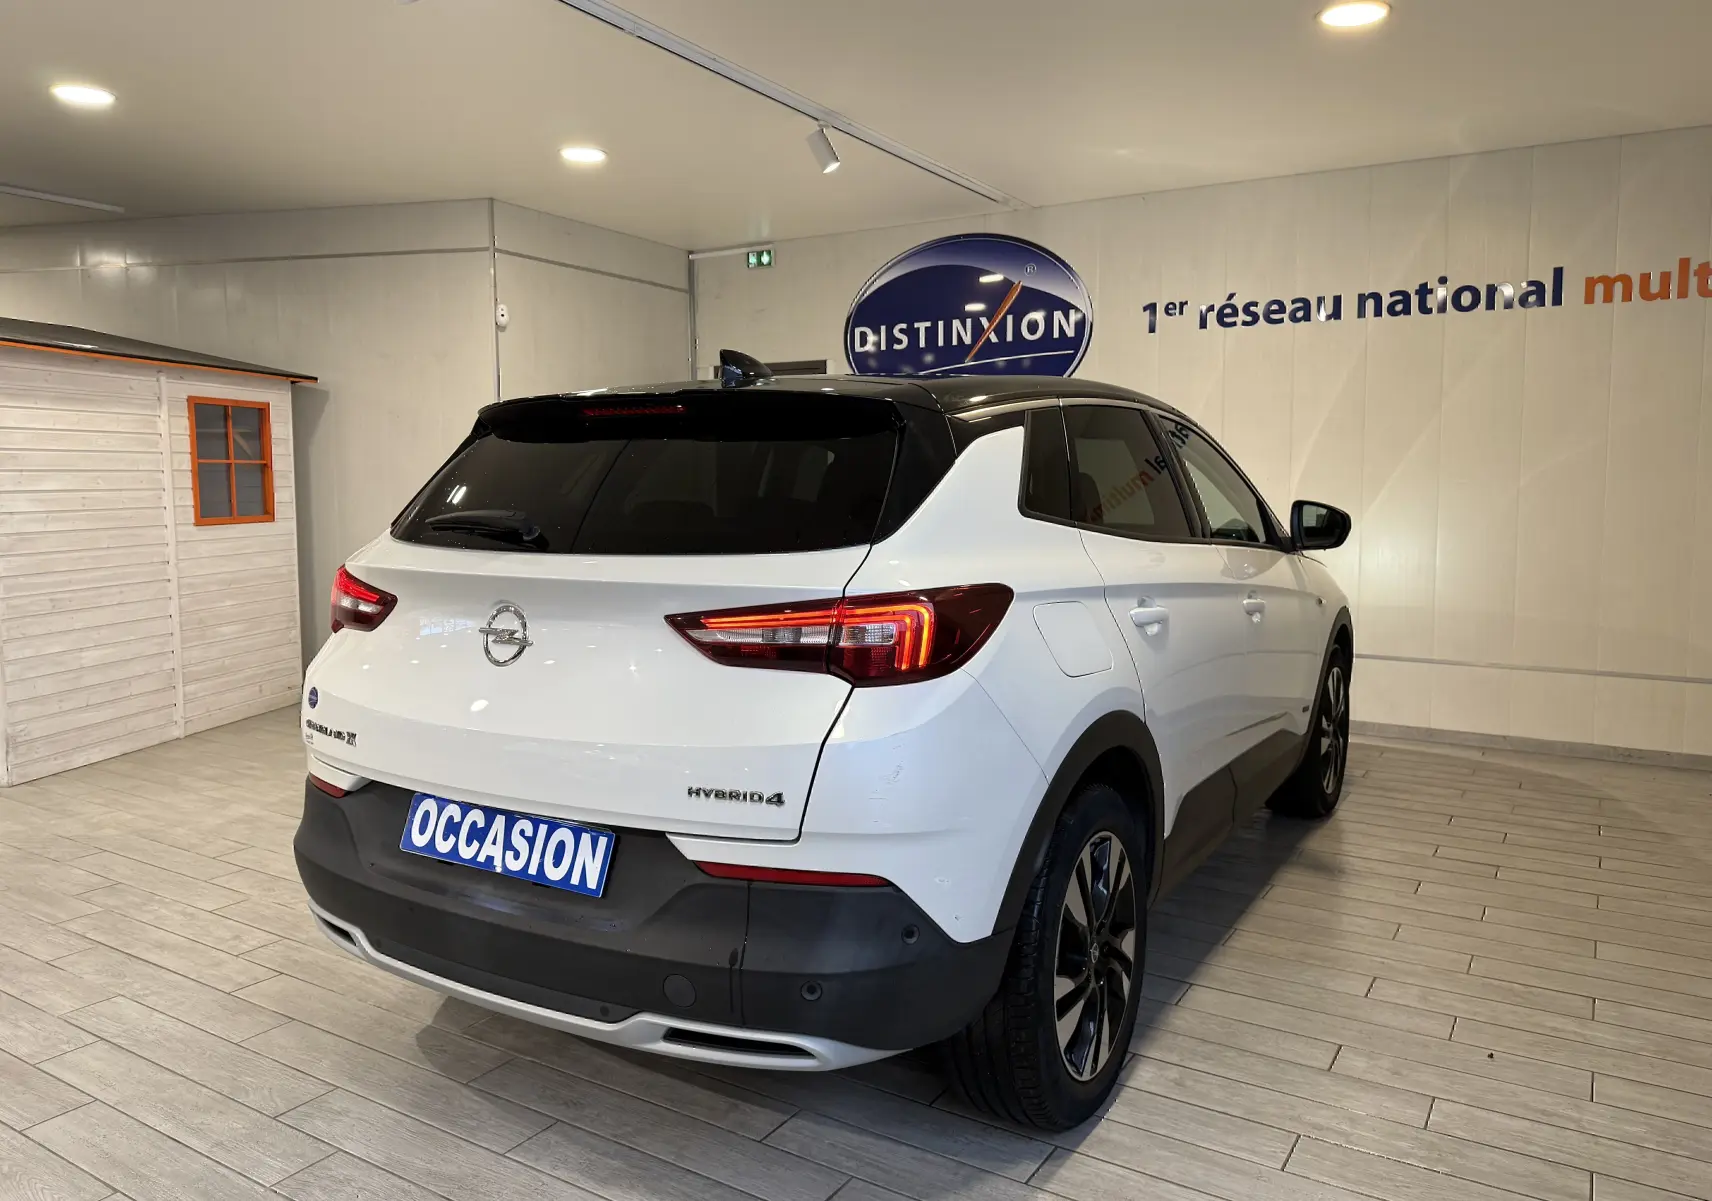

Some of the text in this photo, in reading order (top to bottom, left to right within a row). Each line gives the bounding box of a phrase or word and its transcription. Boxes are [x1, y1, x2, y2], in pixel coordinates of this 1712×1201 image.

[1199, 292, 1343, 330] réseau
[1357, 266, 1564, 319] national
[1583, 257, 1712, 306] mult
[854, 309, 1076, 353] DISTINXION
[410, 798, 608, 890] OCCASION
